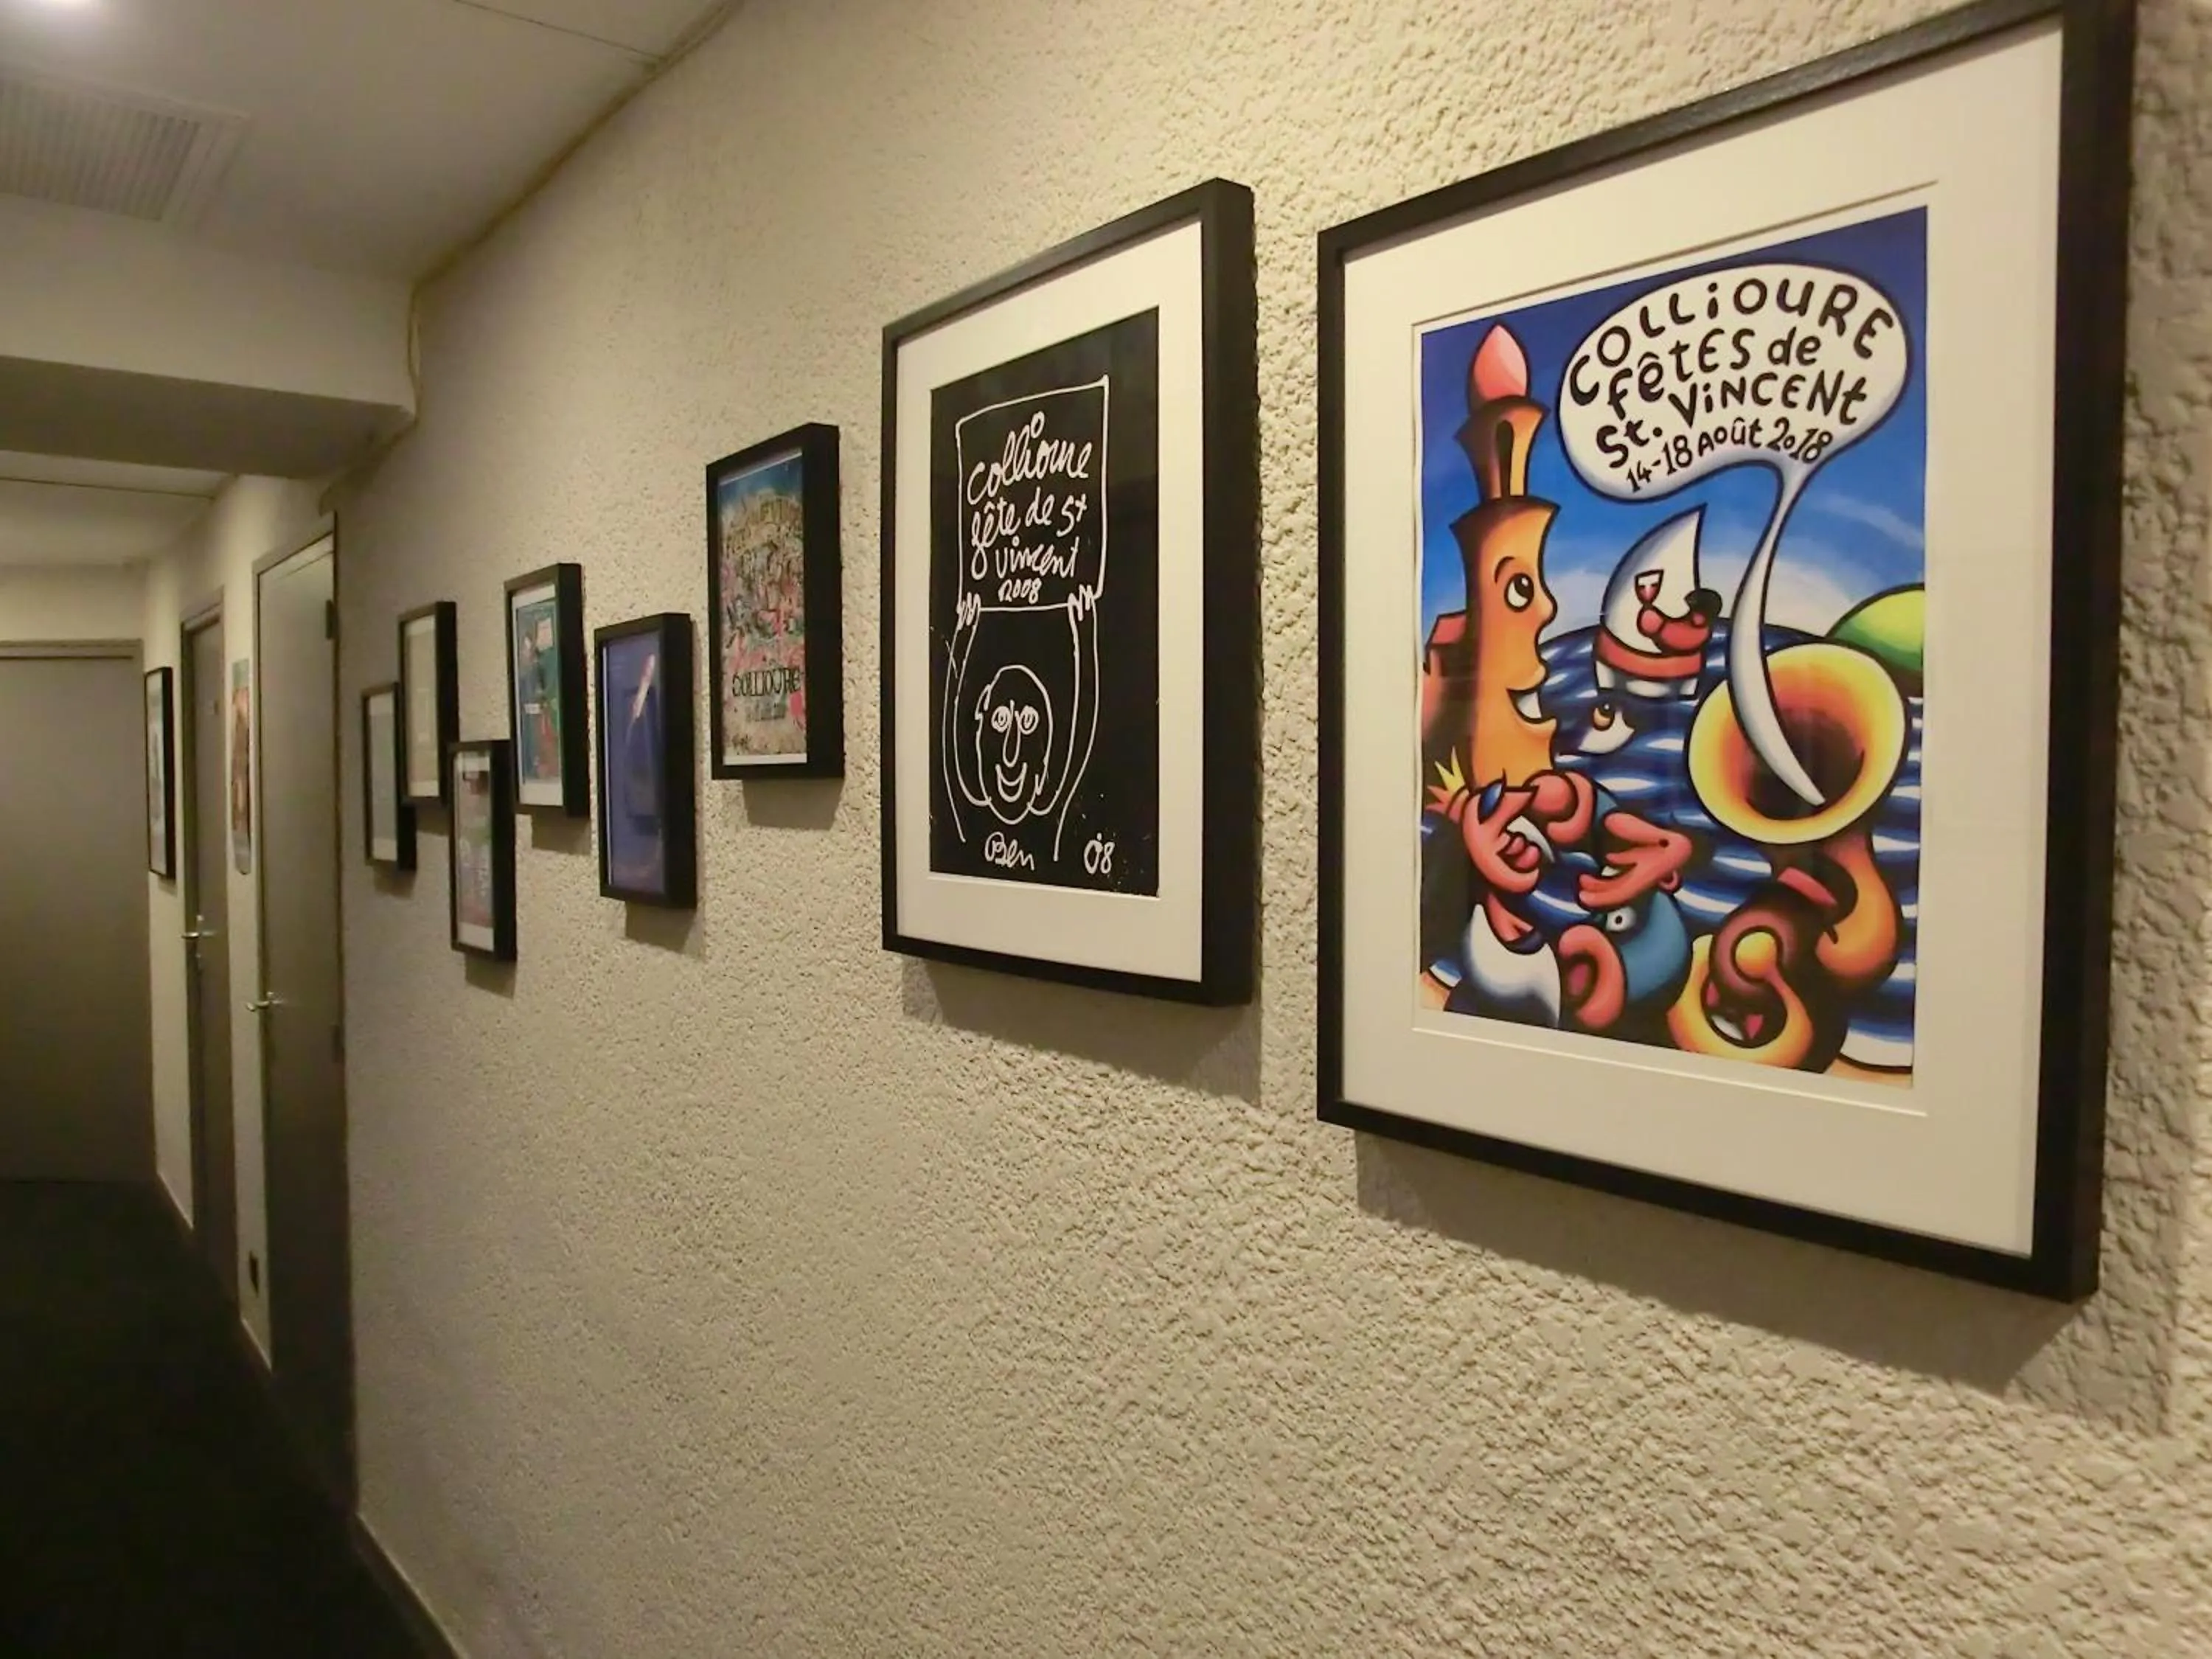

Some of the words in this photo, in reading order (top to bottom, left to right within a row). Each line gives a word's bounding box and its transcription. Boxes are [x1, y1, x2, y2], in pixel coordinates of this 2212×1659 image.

[1767, 327, 1820, 366] de
[1766, 417, 1834, 465] 2018
[1026, 487, 1055, 526] de
[998, 577, 1042, 604] 2008
